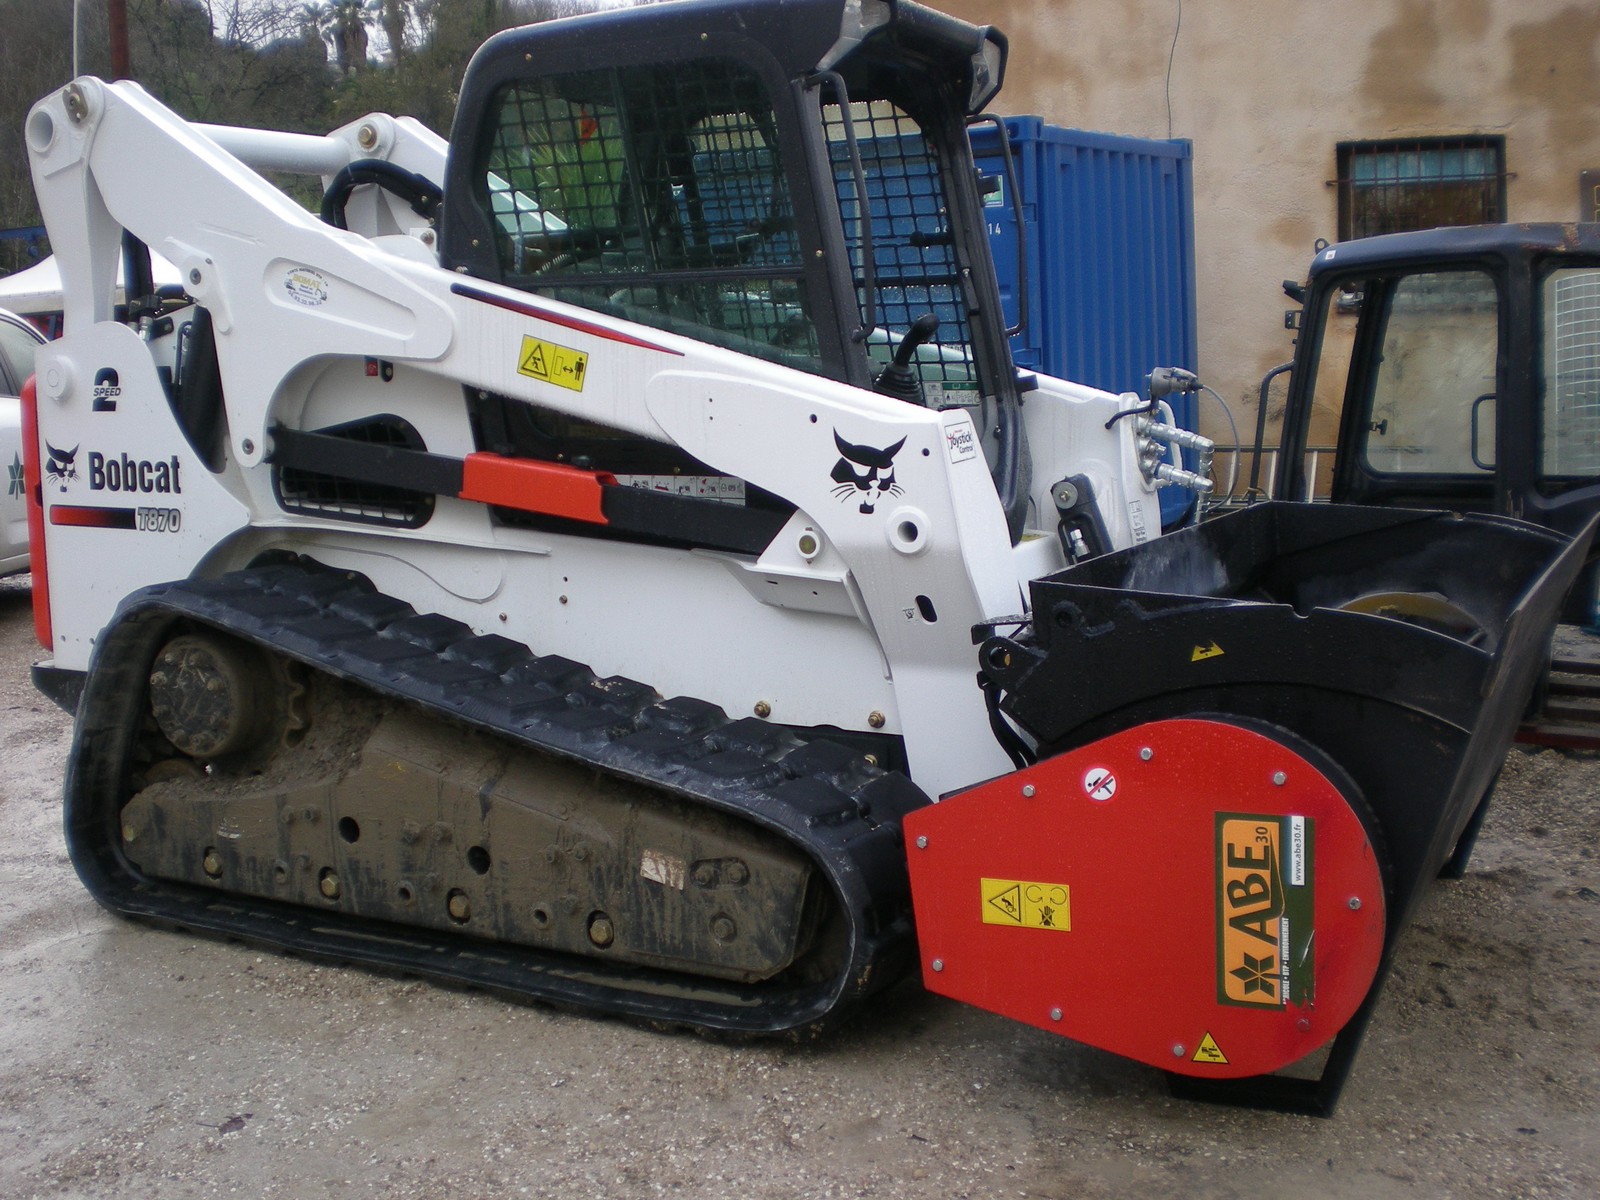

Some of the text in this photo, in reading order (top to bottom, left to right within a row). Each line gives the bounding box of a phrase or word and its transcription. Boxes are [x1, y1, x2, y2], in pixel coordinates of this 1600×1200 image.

[92, 367, 119, 412] 2
[93, 387, 121, 397] SPEED
[88, 451, 181, 494] Bobcat
[137, 506, 181, 533] T870
[1227, 826, 1278, 947] ABE 30
